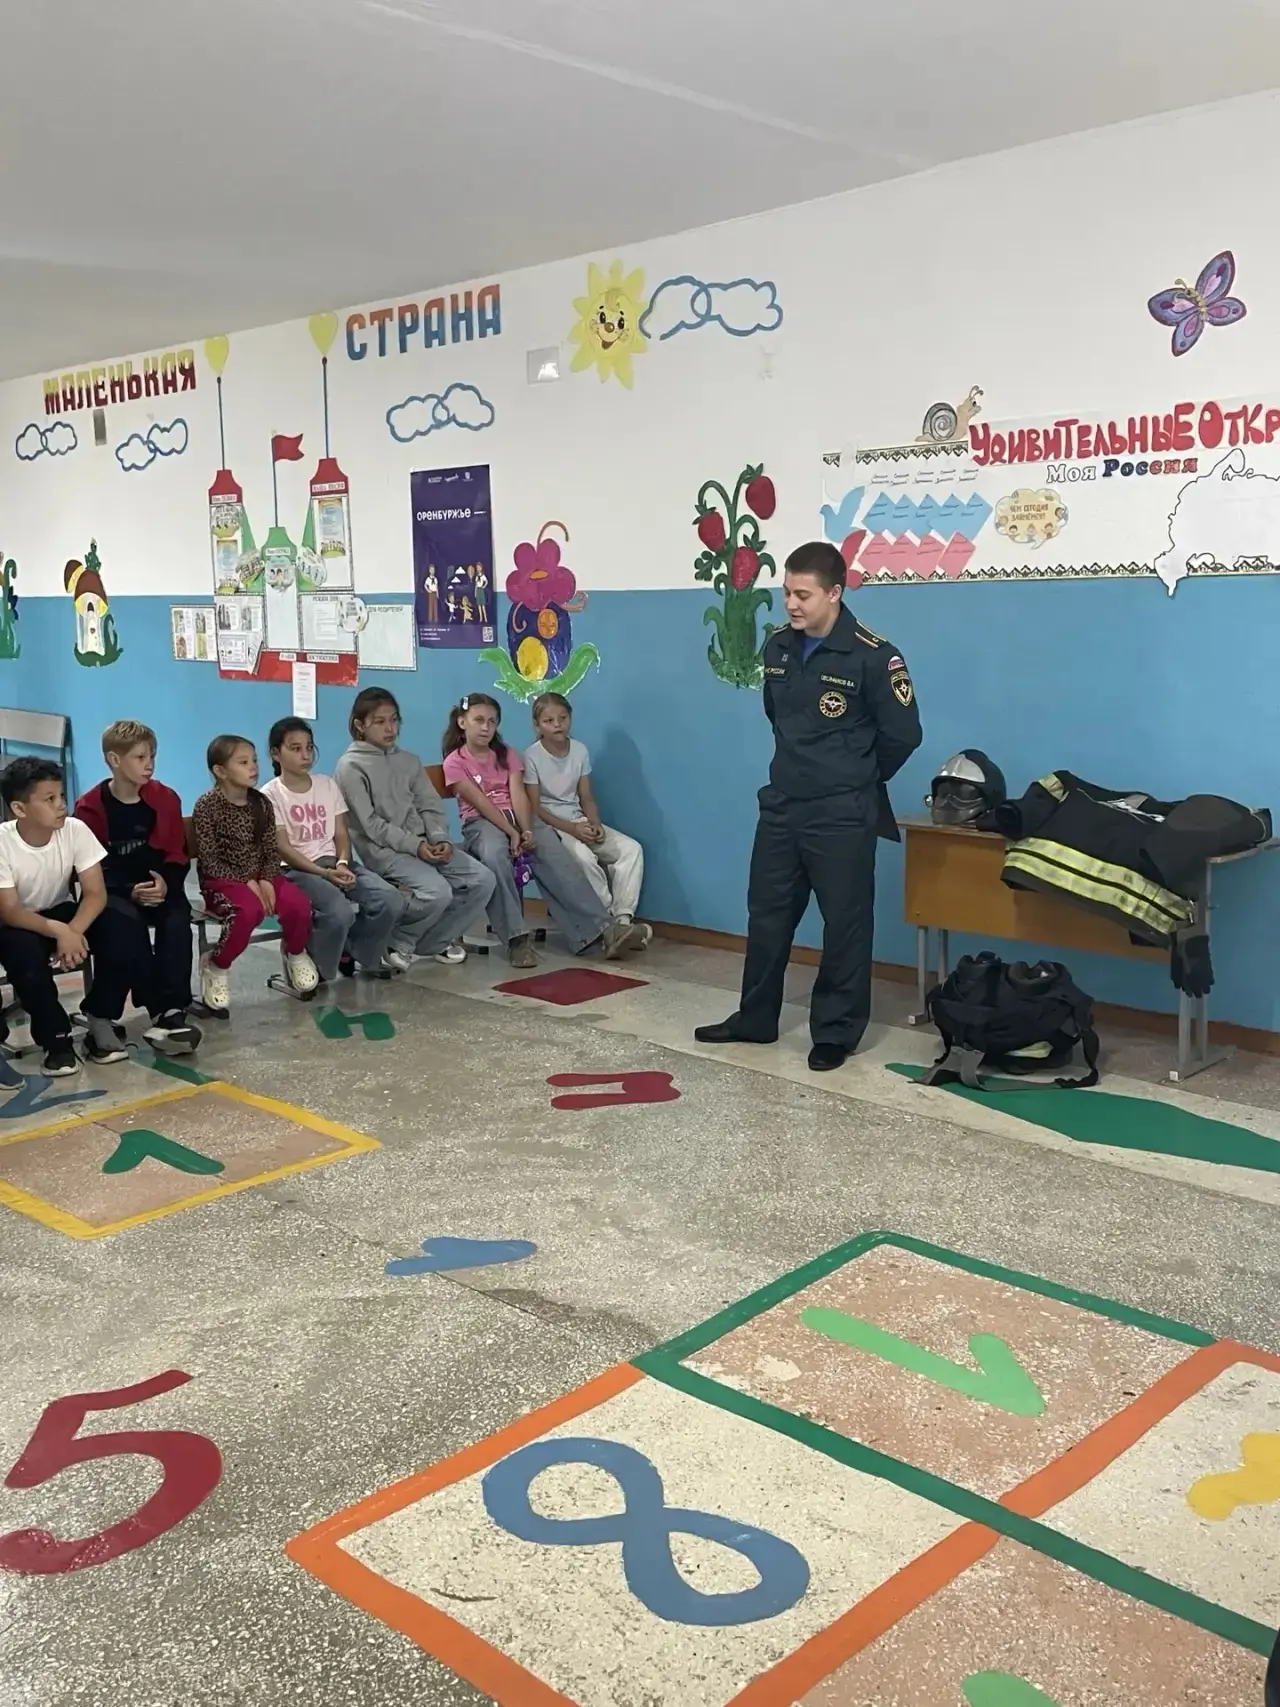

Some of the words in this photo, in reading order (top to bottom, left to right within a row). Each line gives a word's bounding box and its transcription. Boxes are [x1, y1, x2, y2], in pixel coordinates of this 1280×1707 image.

[43, 350, 196, 415] МАЛЕНЬКАЯ
[346, 284, 502, 361] СТРАНА
[1023, 503, 1048, 513] СЕГОДНЯ
[1046, 464, 1096, 483] Моя
[1102, 458, 1198, 477] Россия
[0, 1369, 224, 1575] 5
[482, 1437, 810, 1627] 8
